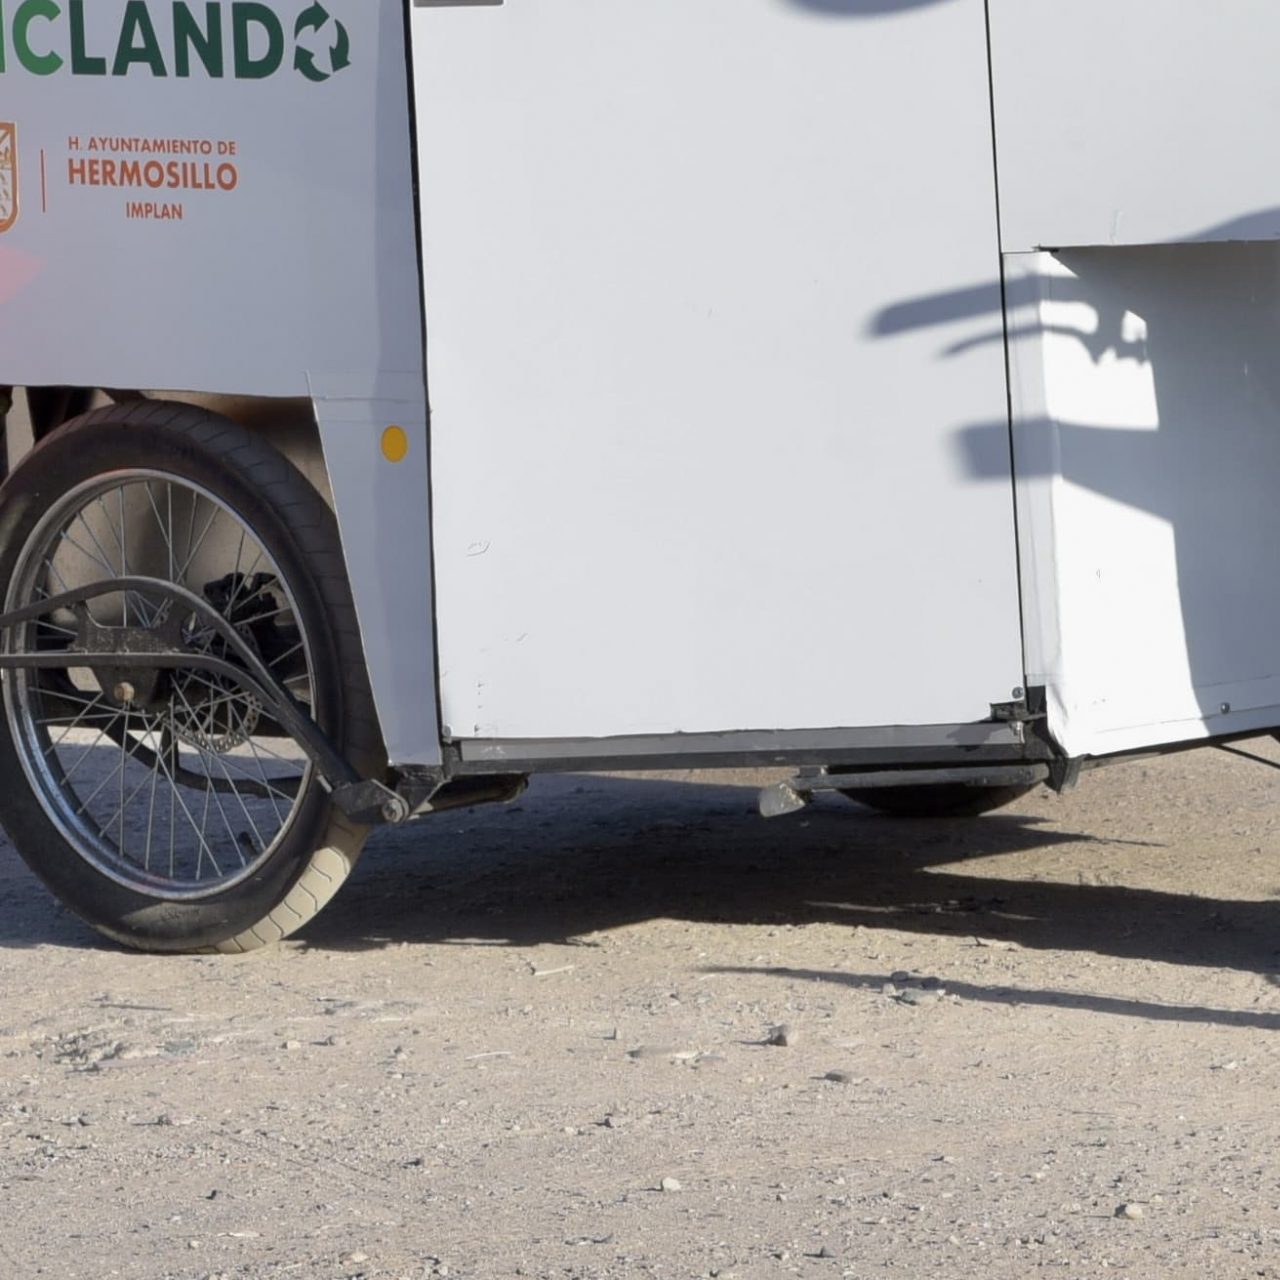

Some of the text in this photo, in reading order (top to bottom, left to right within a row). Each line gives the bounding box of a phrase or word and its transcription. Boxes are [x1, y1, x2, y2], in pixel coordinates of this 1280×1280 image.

[68, 136, 236, 156] H. AYUNTAMIENTO DE
[68, 158, 238, 191] HERMOSILLO
[126, 202, 183, 220] IMPLAN
